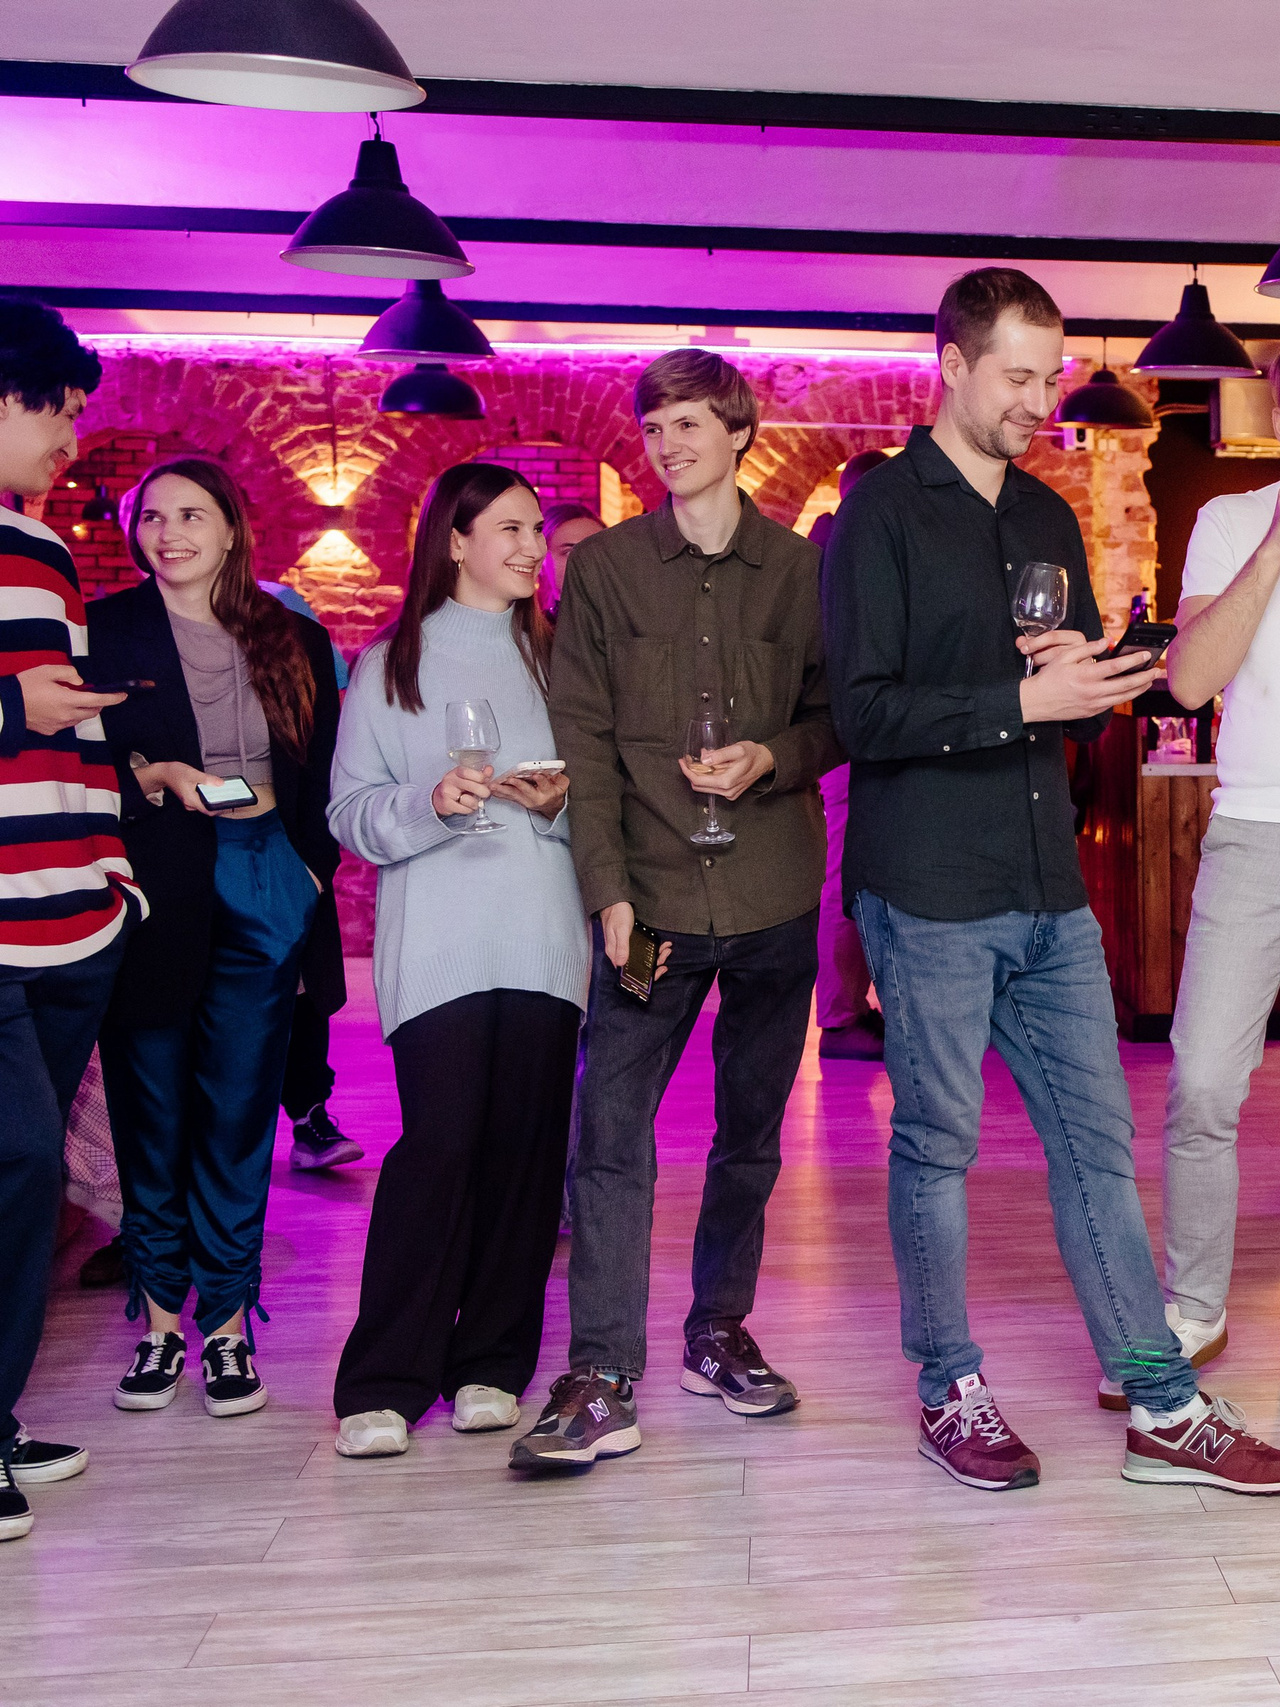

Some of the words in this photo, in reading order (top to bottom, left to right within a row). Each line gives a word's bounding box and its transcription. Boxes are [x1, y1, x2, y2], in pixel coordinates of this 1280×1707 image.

[700, 1356, 720, 1379] N
[588, 1397, 610, 1422] N
[934, 1418, 968, 1456] N
[1185, 1423, 1235, 1464] N
